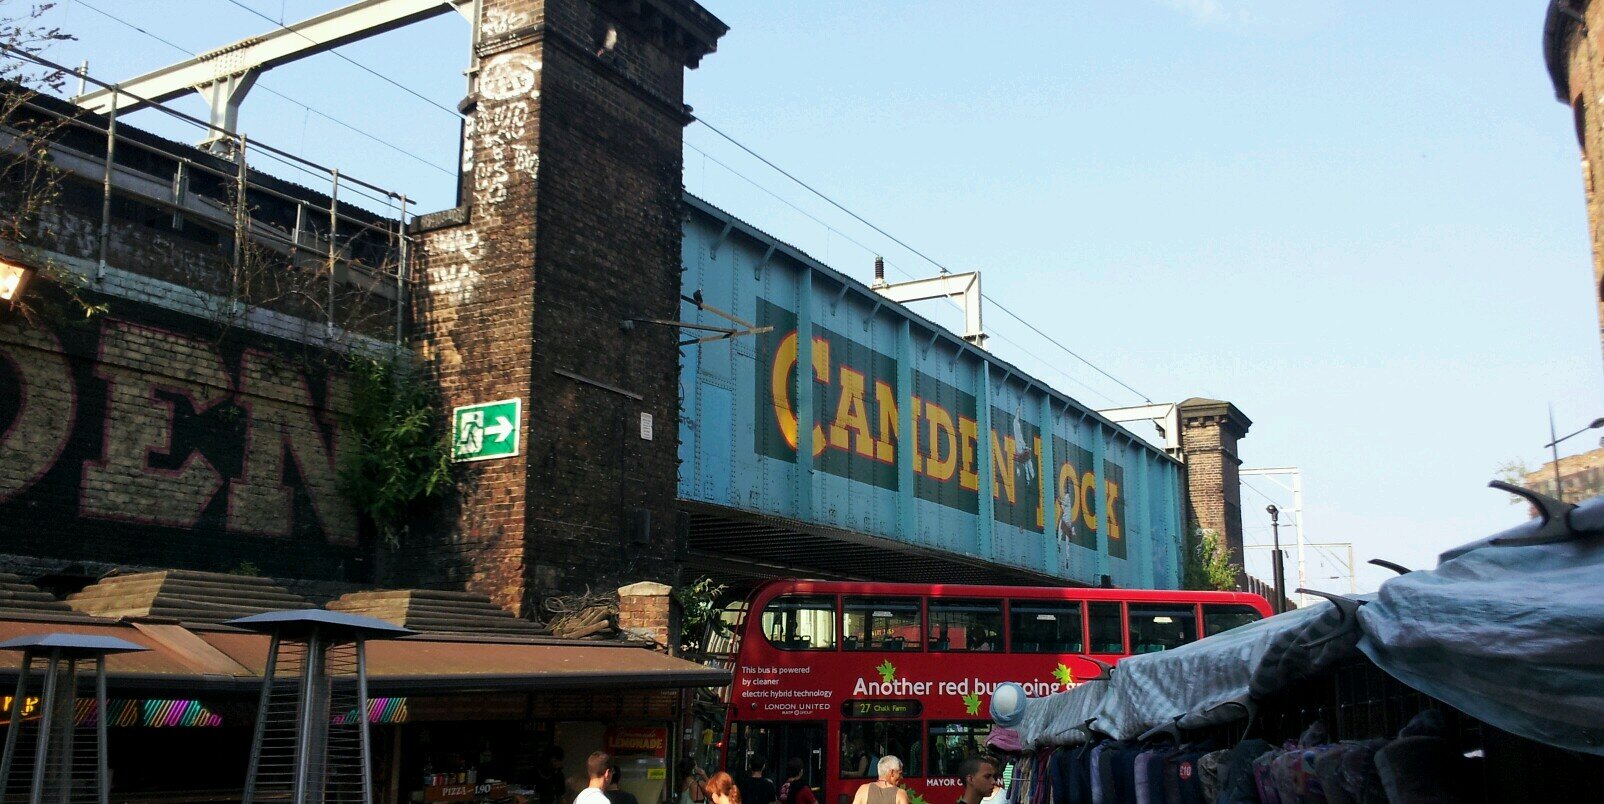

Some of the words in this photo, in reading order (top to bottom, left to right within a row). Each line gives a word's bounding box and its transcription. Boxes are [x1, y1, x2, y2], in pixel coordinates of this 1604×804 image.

[772, 329, 1016, 504] CAMDEN
[742, 666, 756, 674] This
[757, 666, 771, 674] bus
[772, 666, 778, 674] is
[779, 666, 810, 676] powered
[742, 678, 751, 686] by
[852, 677, 932, 696] Another
[938, 677, 969, 696] red
[742, 690, 769, 698] electric
[770, 690, 792, 699] hybrid
[793, 689, 832, 698] technology
[860, 703, 871, 714] 27
[873, 704, 890, 712] Chalk
[892, 704, 907, 712] Farm
[926, 778, 956, 787] MAYOR
[442, 786, 467, 796] PIZZA
